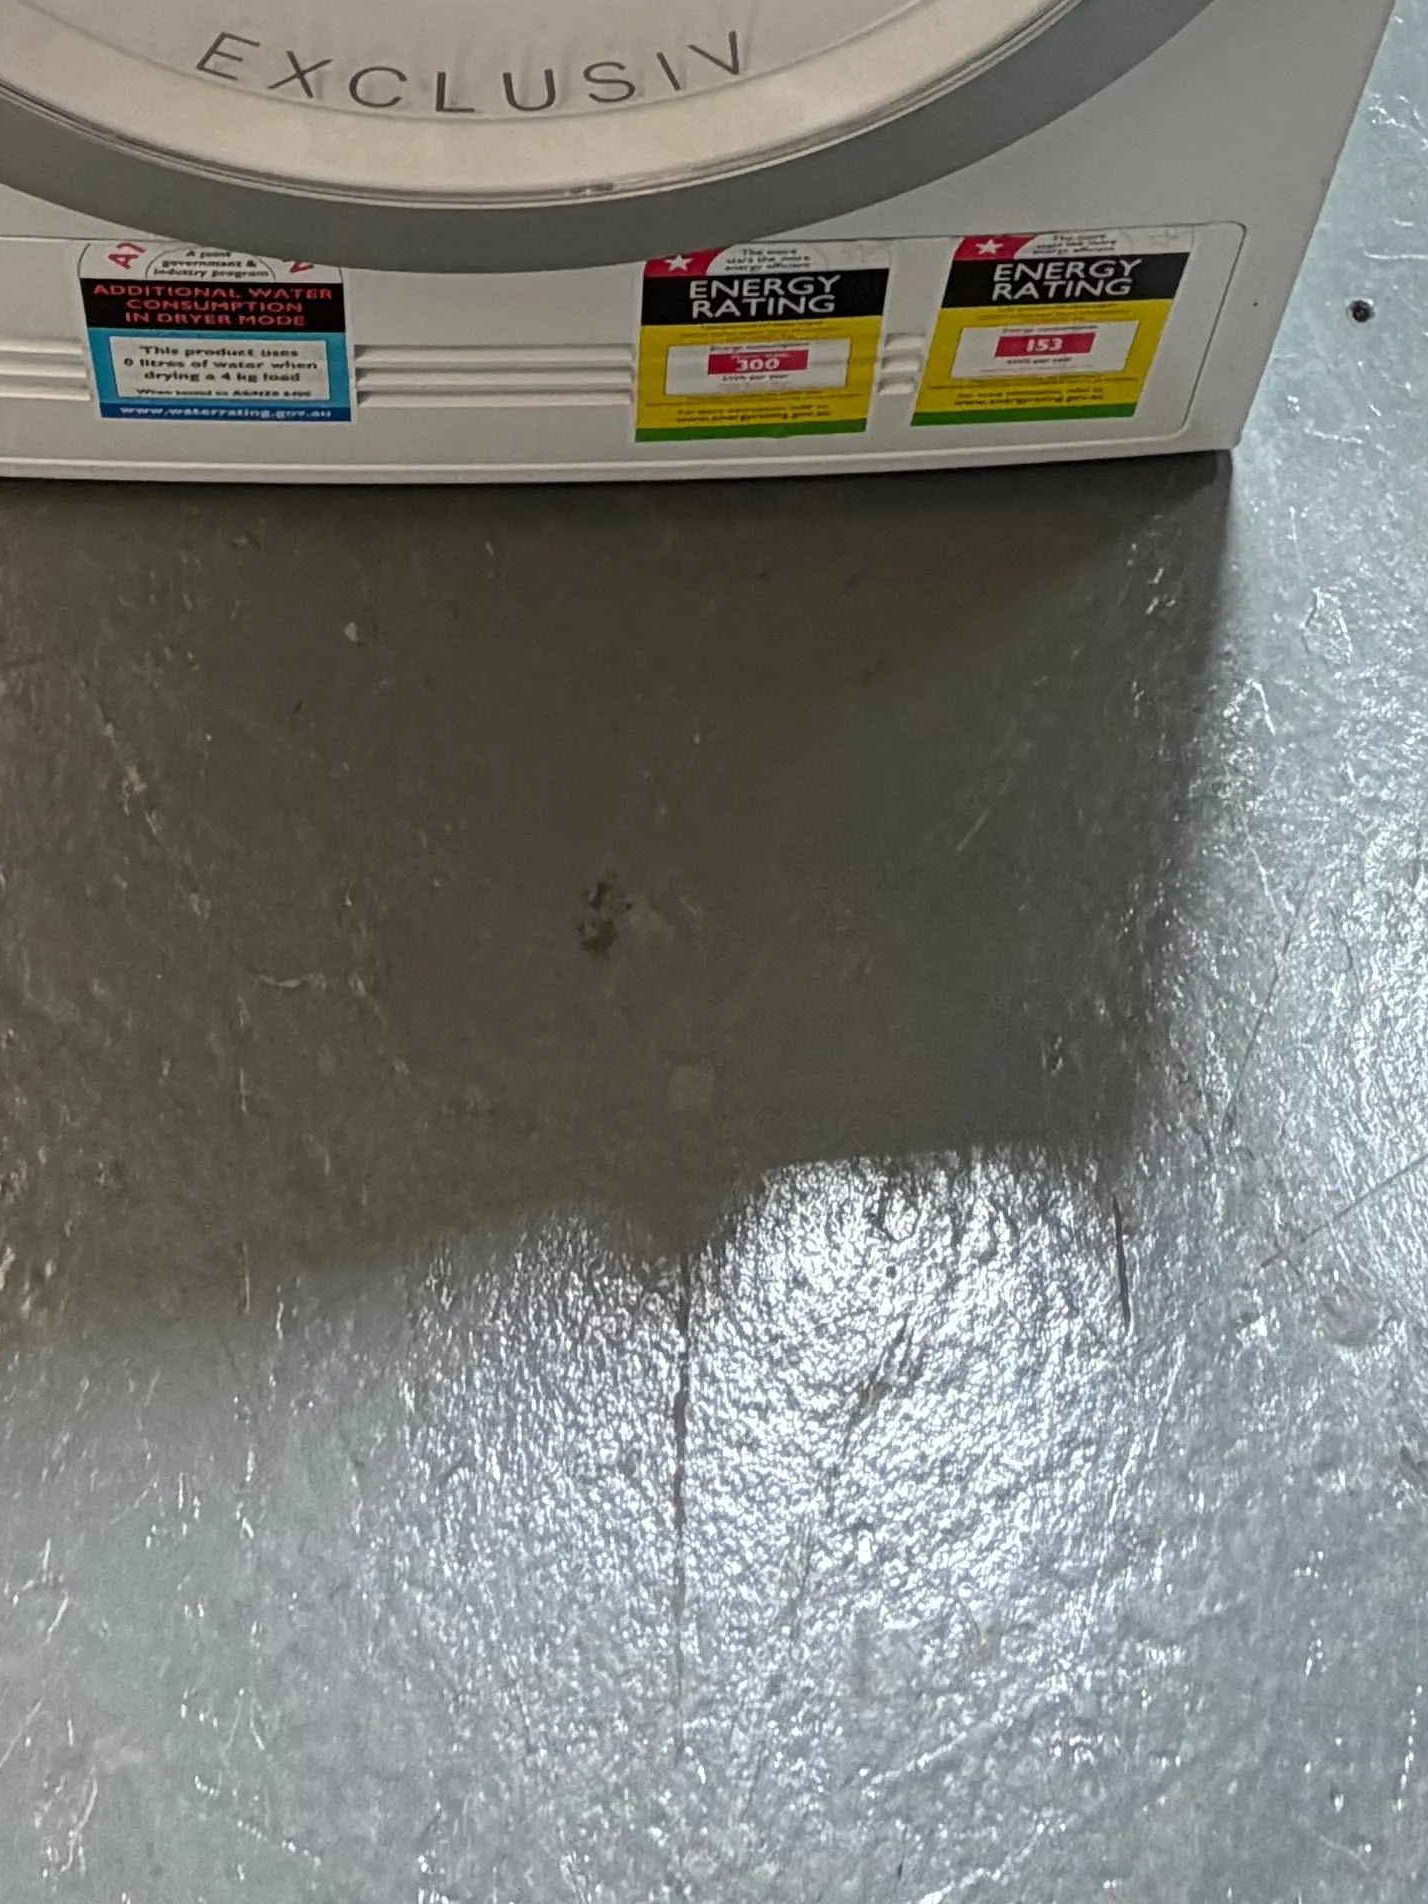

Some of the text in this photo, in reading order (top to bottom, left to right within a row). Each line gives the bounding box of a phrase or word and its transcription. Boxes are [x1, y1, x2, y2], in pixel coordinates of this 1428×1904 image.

[196, 31, 741, 114] EXCLUSIV
[993, 258, 1142, 283] ENERGY
[92, 284, 334, 300] ADDITIONAL WATER
[689, 274, 842, 300] ENERGY
[991, 278, 1133, 302] RATING
[125, 299, 304, 314] CONSUMPTION
[691, 294, 836, 320] RATING
[125, 312, 307, 327] IN DRYER MODE
[139, 346, 179, 356] This
[185, 348, 254, 358] product
[1026, 338, 1063, 352] 153
[213, 360, 264, 369] water
[271, 360, 318, 369] when
[735, 358, 780, 372] 300
[144, 371, 200, 382] drying
[120, 407, 331, 419] www.waterrating.gov.au
